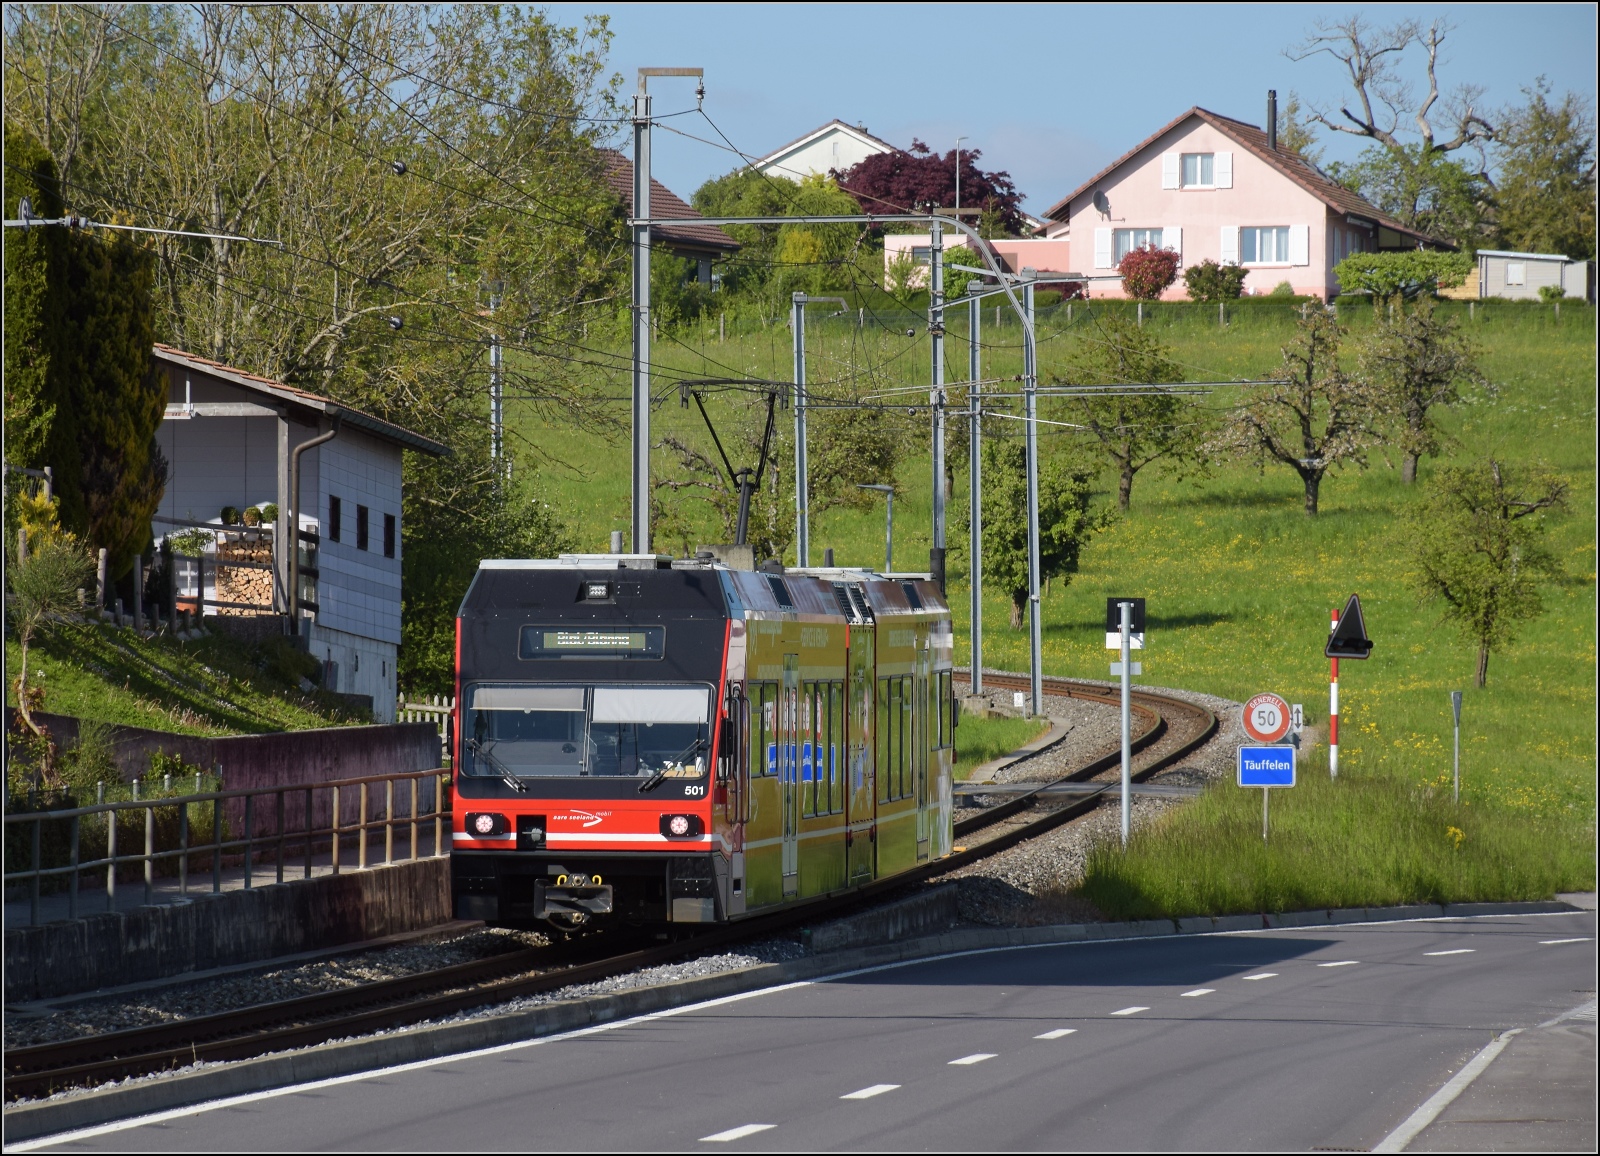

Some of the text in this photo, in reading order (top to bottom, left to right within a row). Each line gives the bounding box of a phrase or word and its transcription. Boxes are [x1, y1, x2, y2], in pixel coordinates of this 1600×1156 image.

[1249, 696, 1284, 709] GENERELL
[1257, 710, 1276, 726] 50
[1244, 759, 1290, 770] Täuffelen
[684, 785, 704, 796] 501
